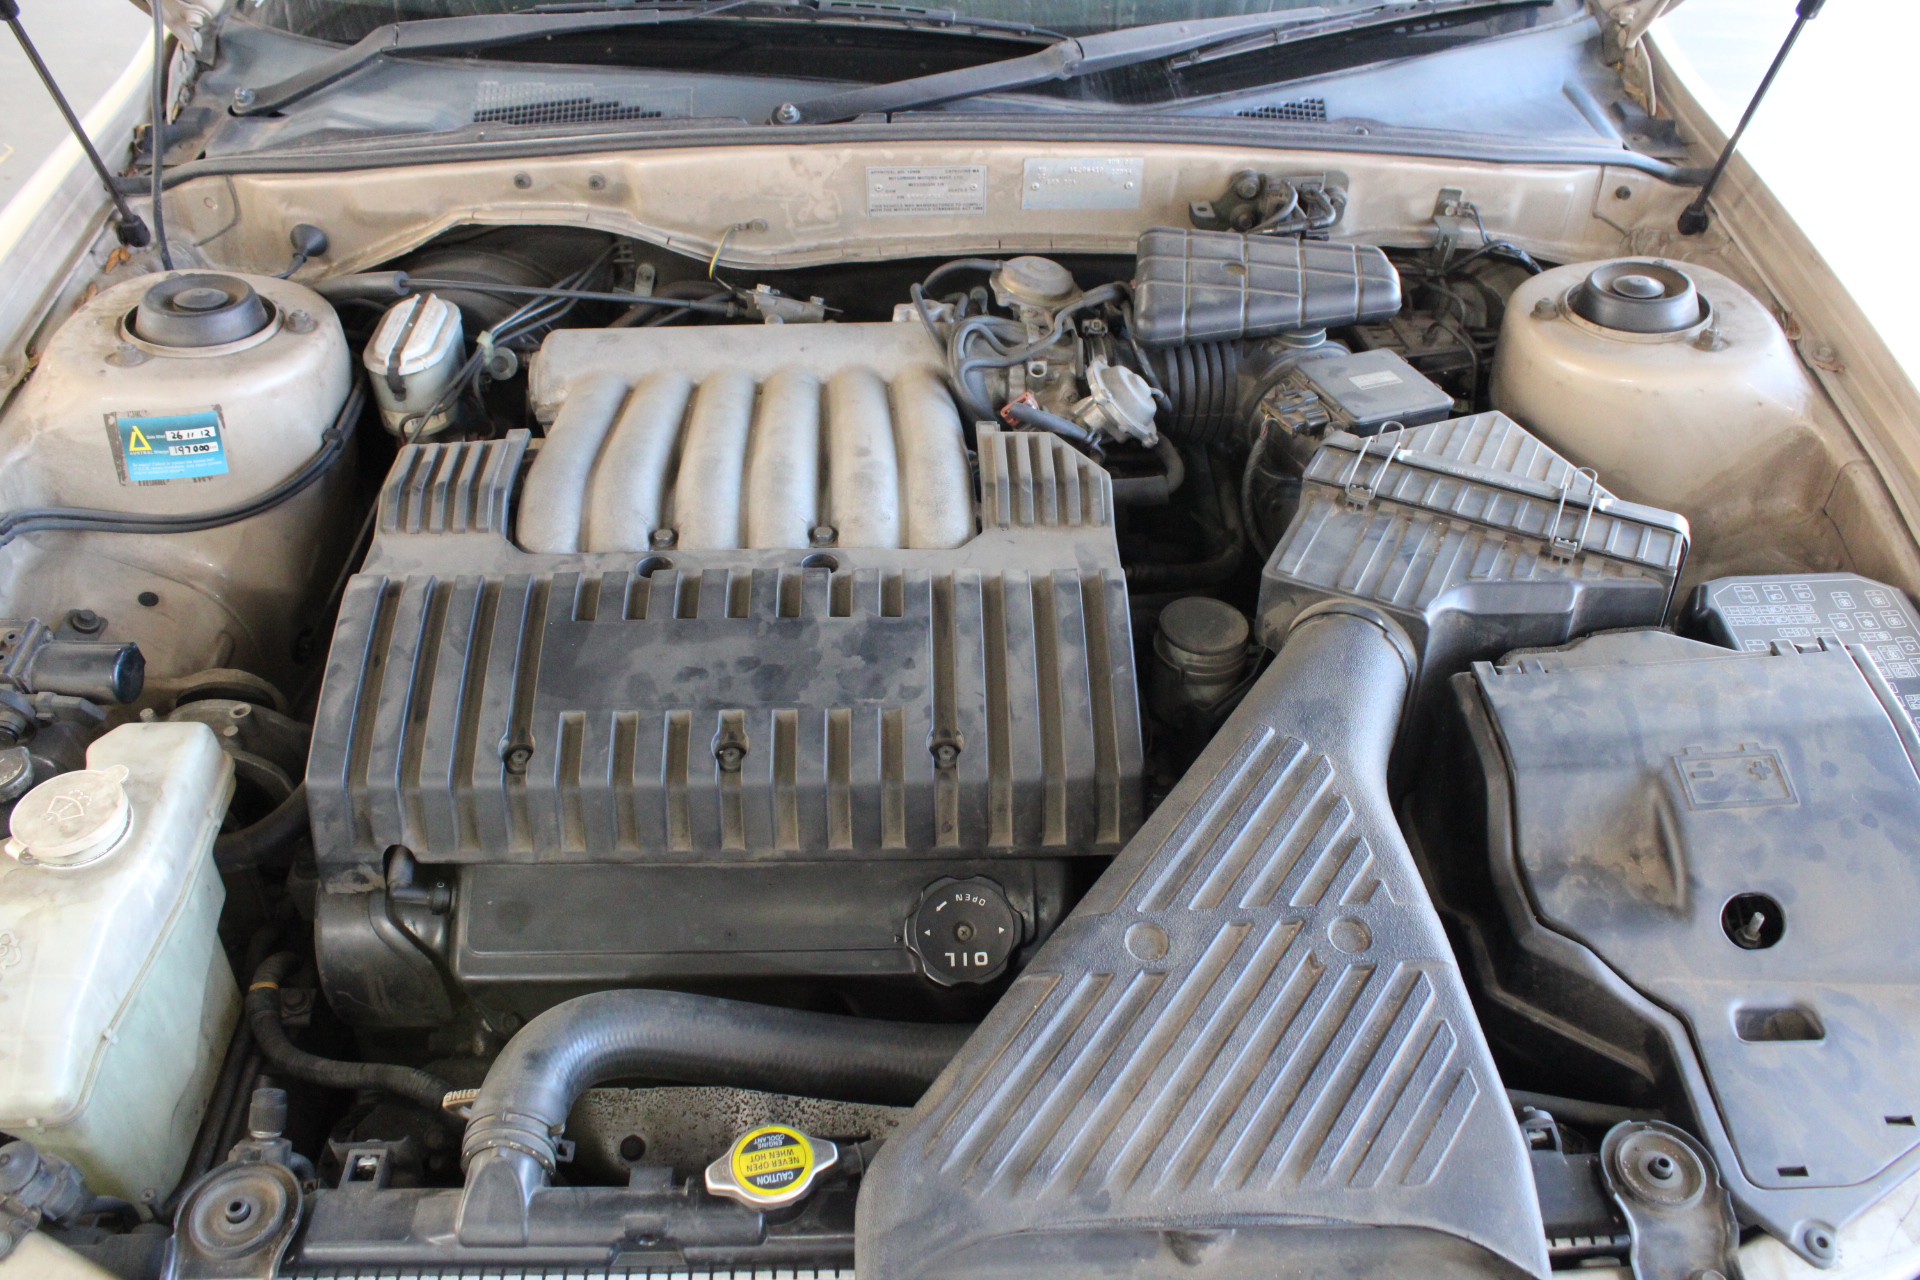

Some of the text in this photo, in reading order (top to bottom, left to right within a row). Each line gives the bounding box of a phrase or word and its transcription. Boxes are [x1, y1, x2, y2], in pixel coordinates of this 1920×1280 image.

[171, 431, 183, 440] 26
[200, 429, 212, 437] 12
[955, 893, 986, 907] OPEN
[944, 951, 988, 967] OIL
[753, 1133, 785, 1145] COOLANT
[757, 1139, 783, 1149] ENGINE
[750, 1148, 794, 1163] WHEN HOT
[746, 1157, 800, 1173] NEVER OPEN
[756, 1171, 794, 1186] CAUTION
